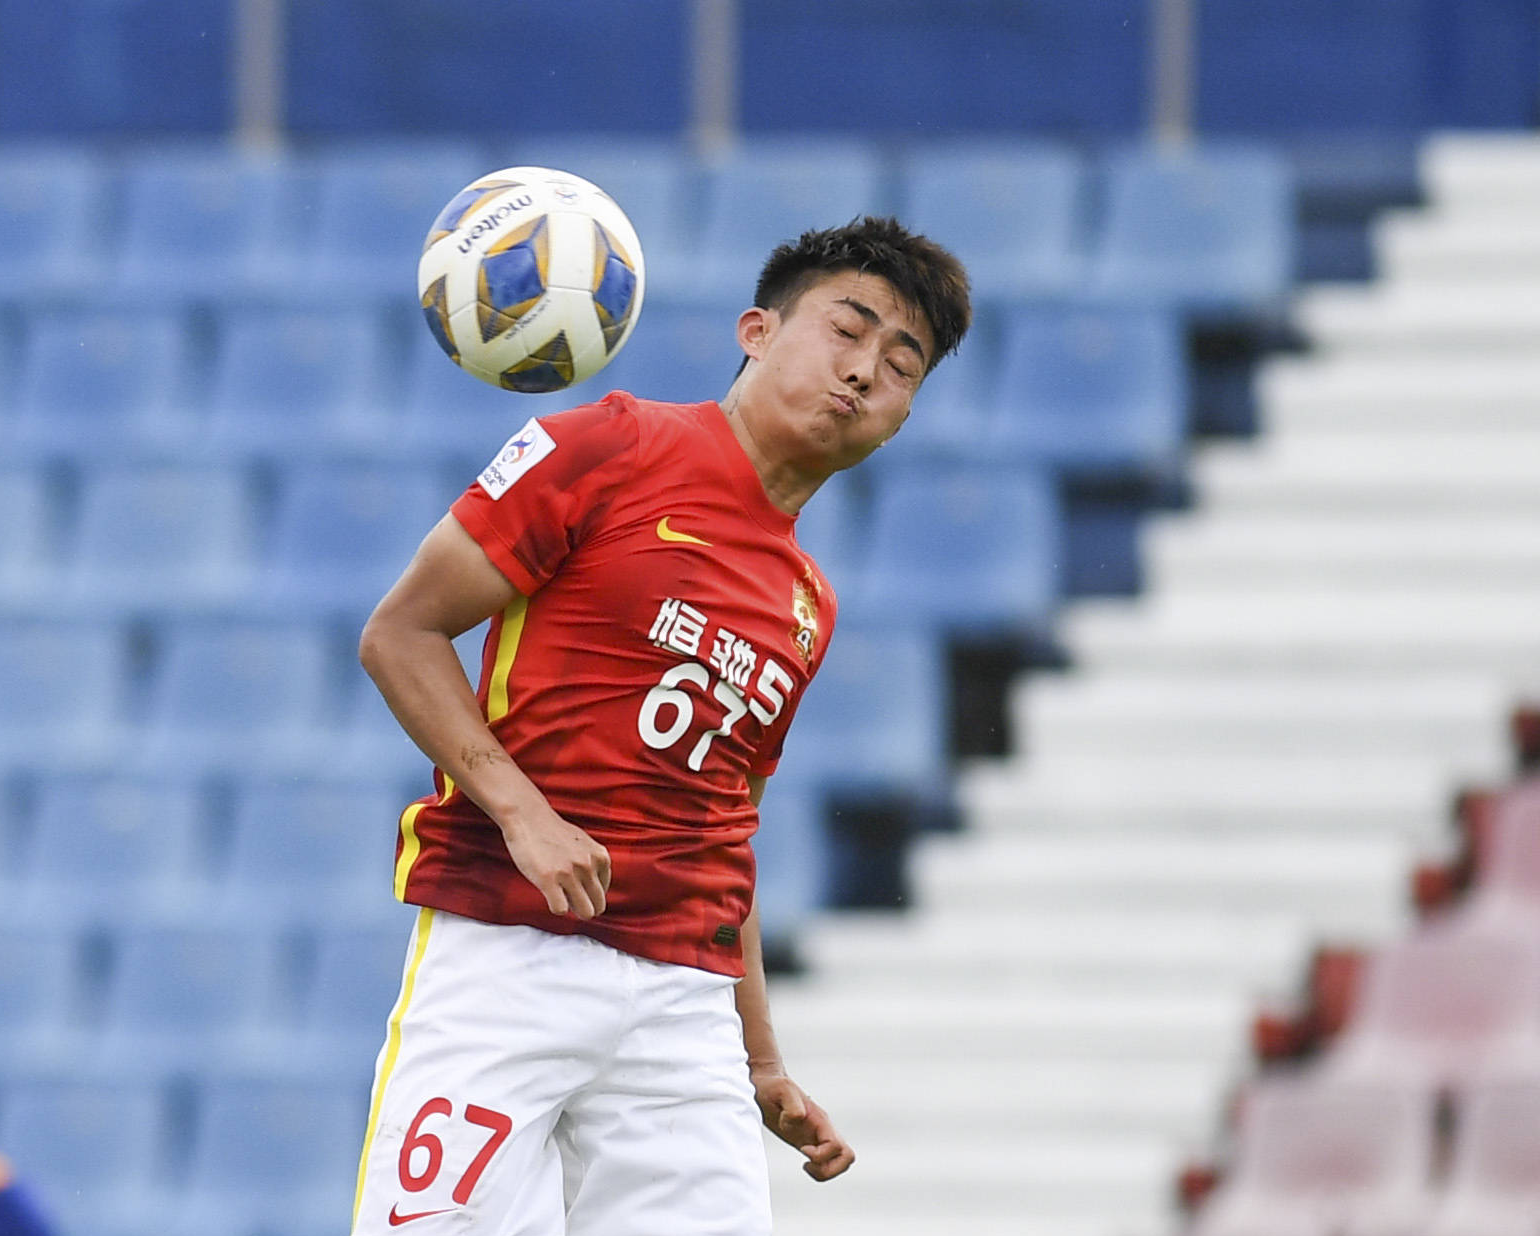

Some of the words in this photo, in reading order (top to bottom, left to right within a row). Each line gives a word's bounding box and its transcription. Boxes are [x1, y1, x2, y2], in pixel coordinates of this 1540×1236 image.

[457, 194, 533, 254] molten
[637, 662, 748, 772] 67
[398, 1096, 513, 1206] 67
